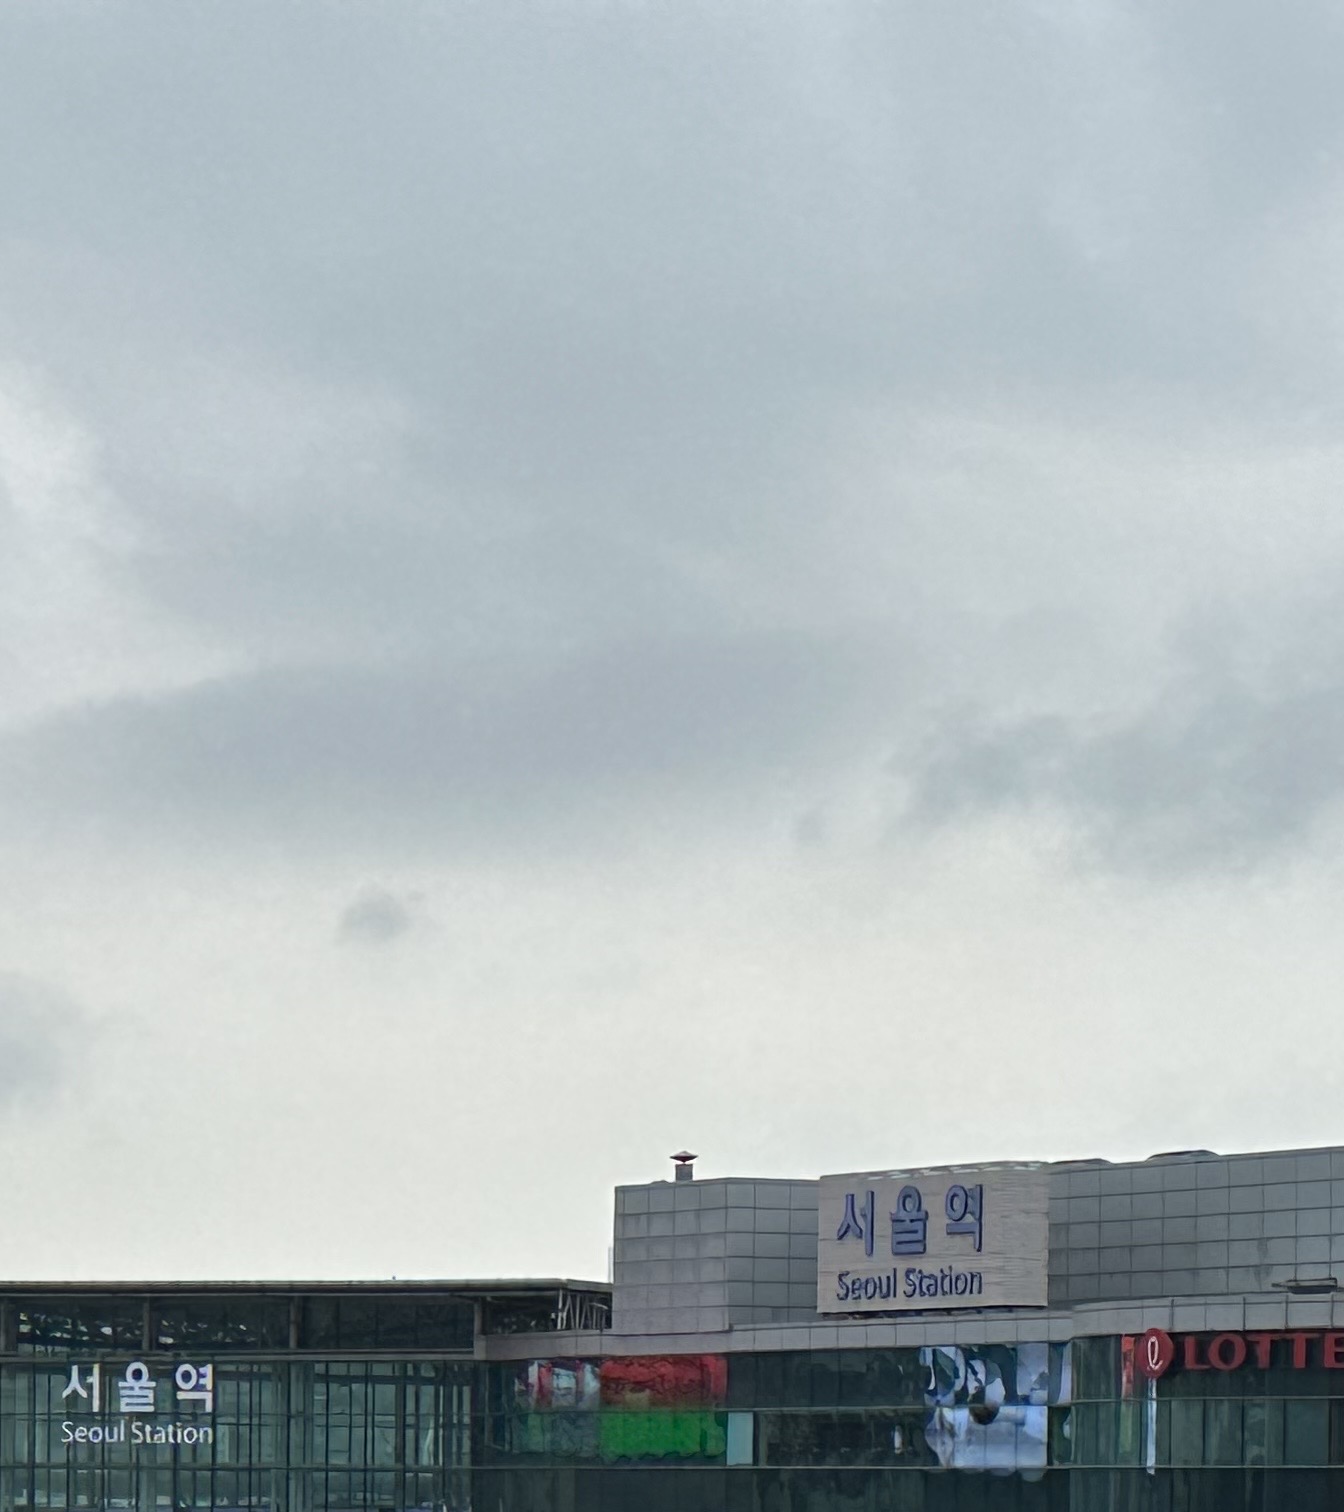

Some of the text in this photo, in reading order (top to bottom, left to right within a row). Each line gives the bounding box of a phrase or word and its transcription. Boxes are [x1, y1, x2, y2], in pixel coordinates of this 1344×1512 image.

[837, 1184, 983, 1256] 서울역
[837, 1265, 982, 1300] Seoul Station
[1184, 1332, 1344, 1370] LOTTE
[61, 1361, 214, 1413] 서울역
[61, 1420, 213, 1445] Seoul Station
